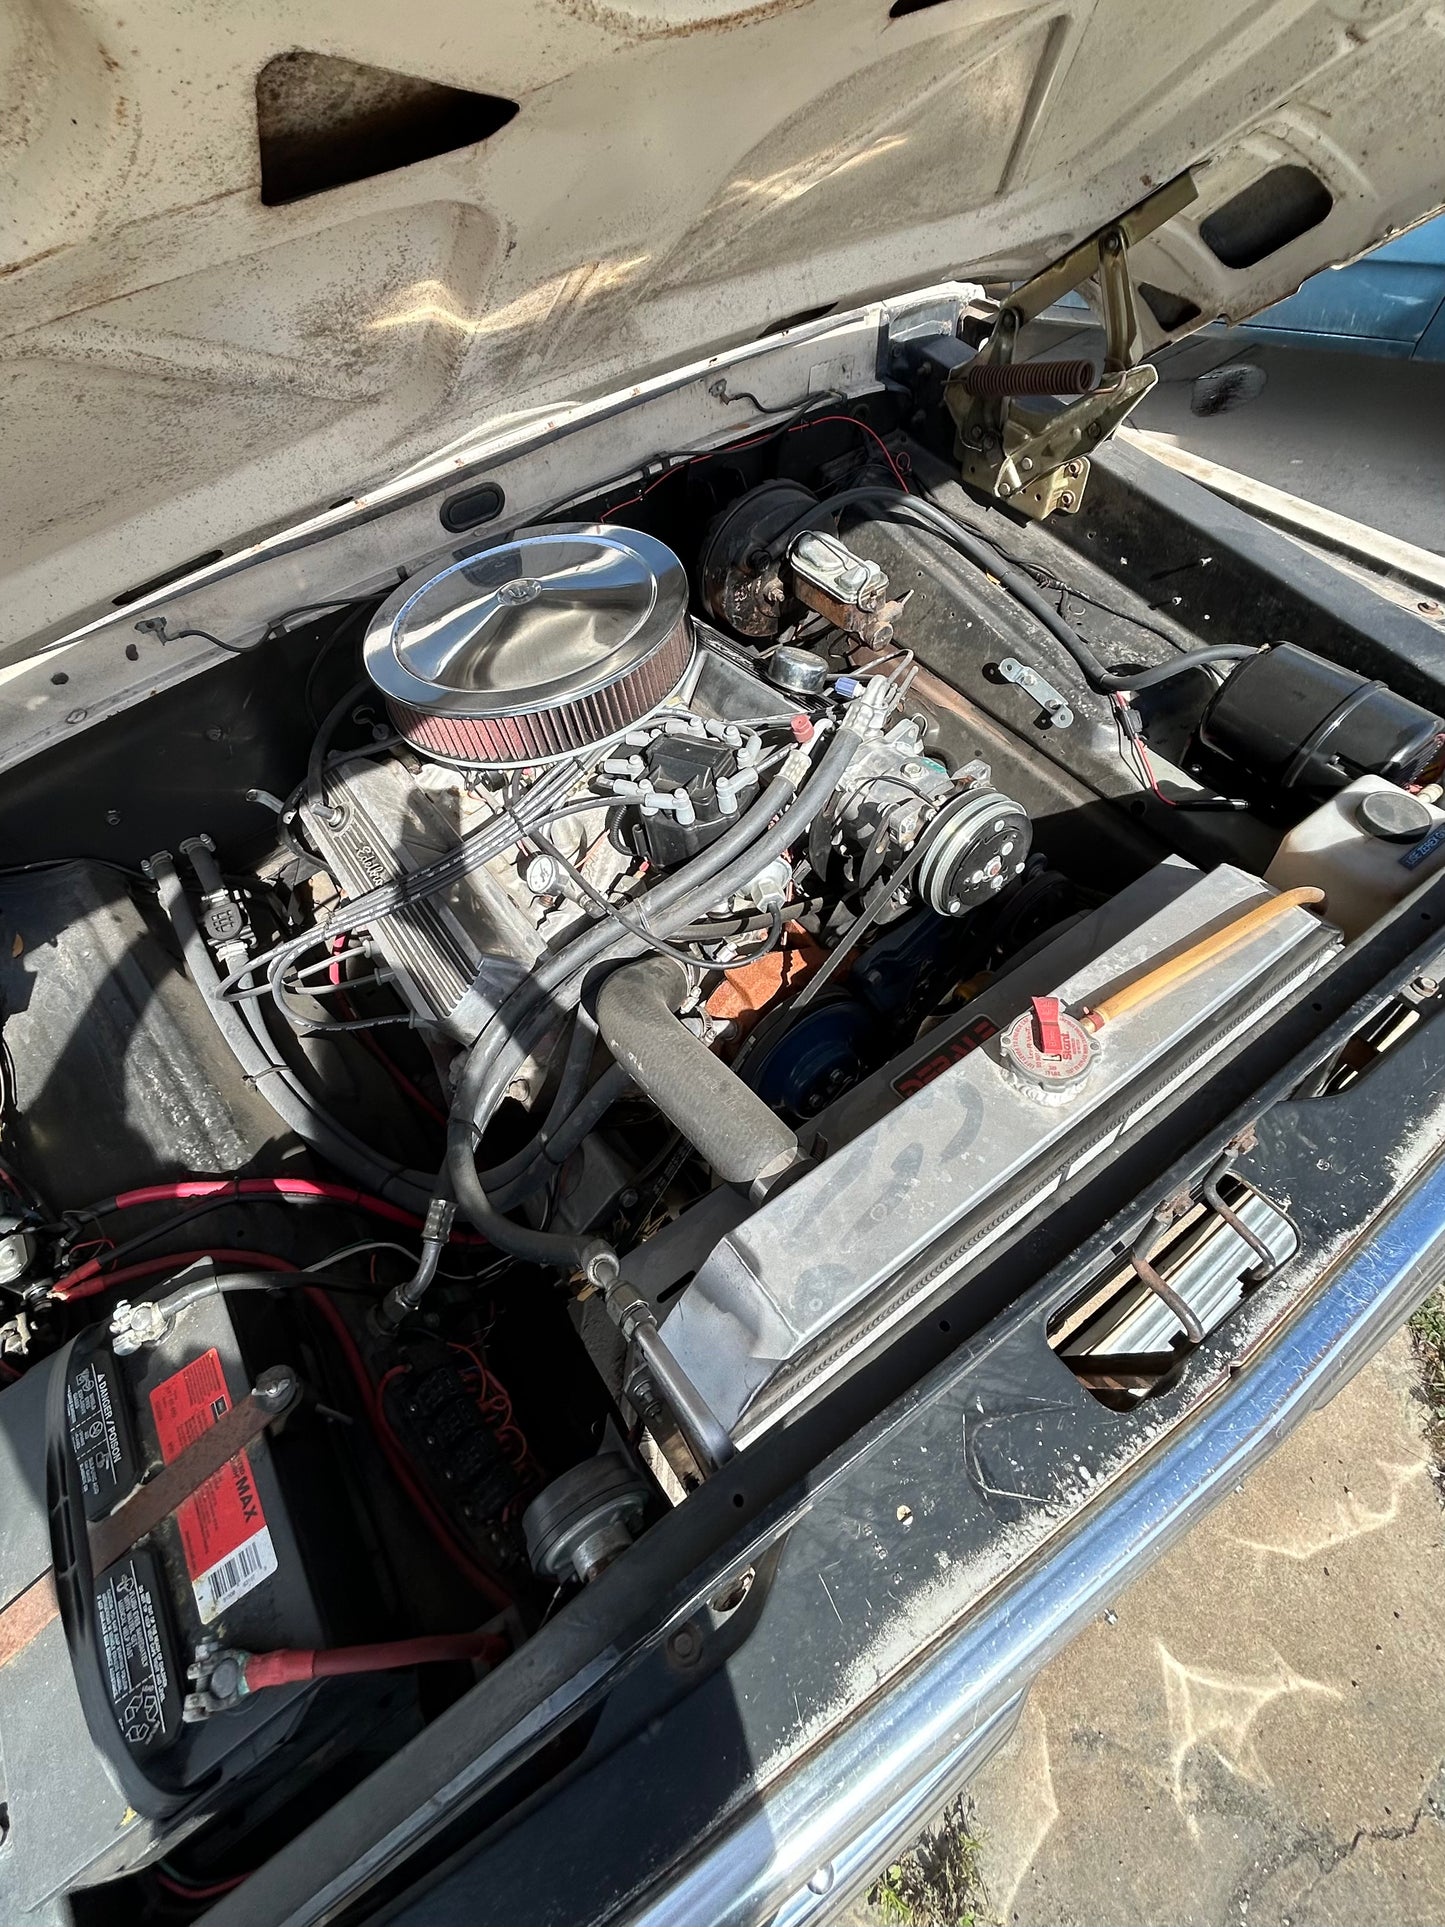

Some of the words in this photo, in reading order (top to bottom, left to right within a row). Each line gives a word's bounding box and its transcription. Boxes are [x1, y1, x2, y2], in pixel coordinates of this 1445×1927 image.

[356, 845, 384, 887] Edelbro
[1061, 1032, 1072, 1060] Stant
[98, 1380, 112, 1419] DANGER
[107, 1425, 121, 1463] POISON
[234, 1474, 258, 1523] MAX
